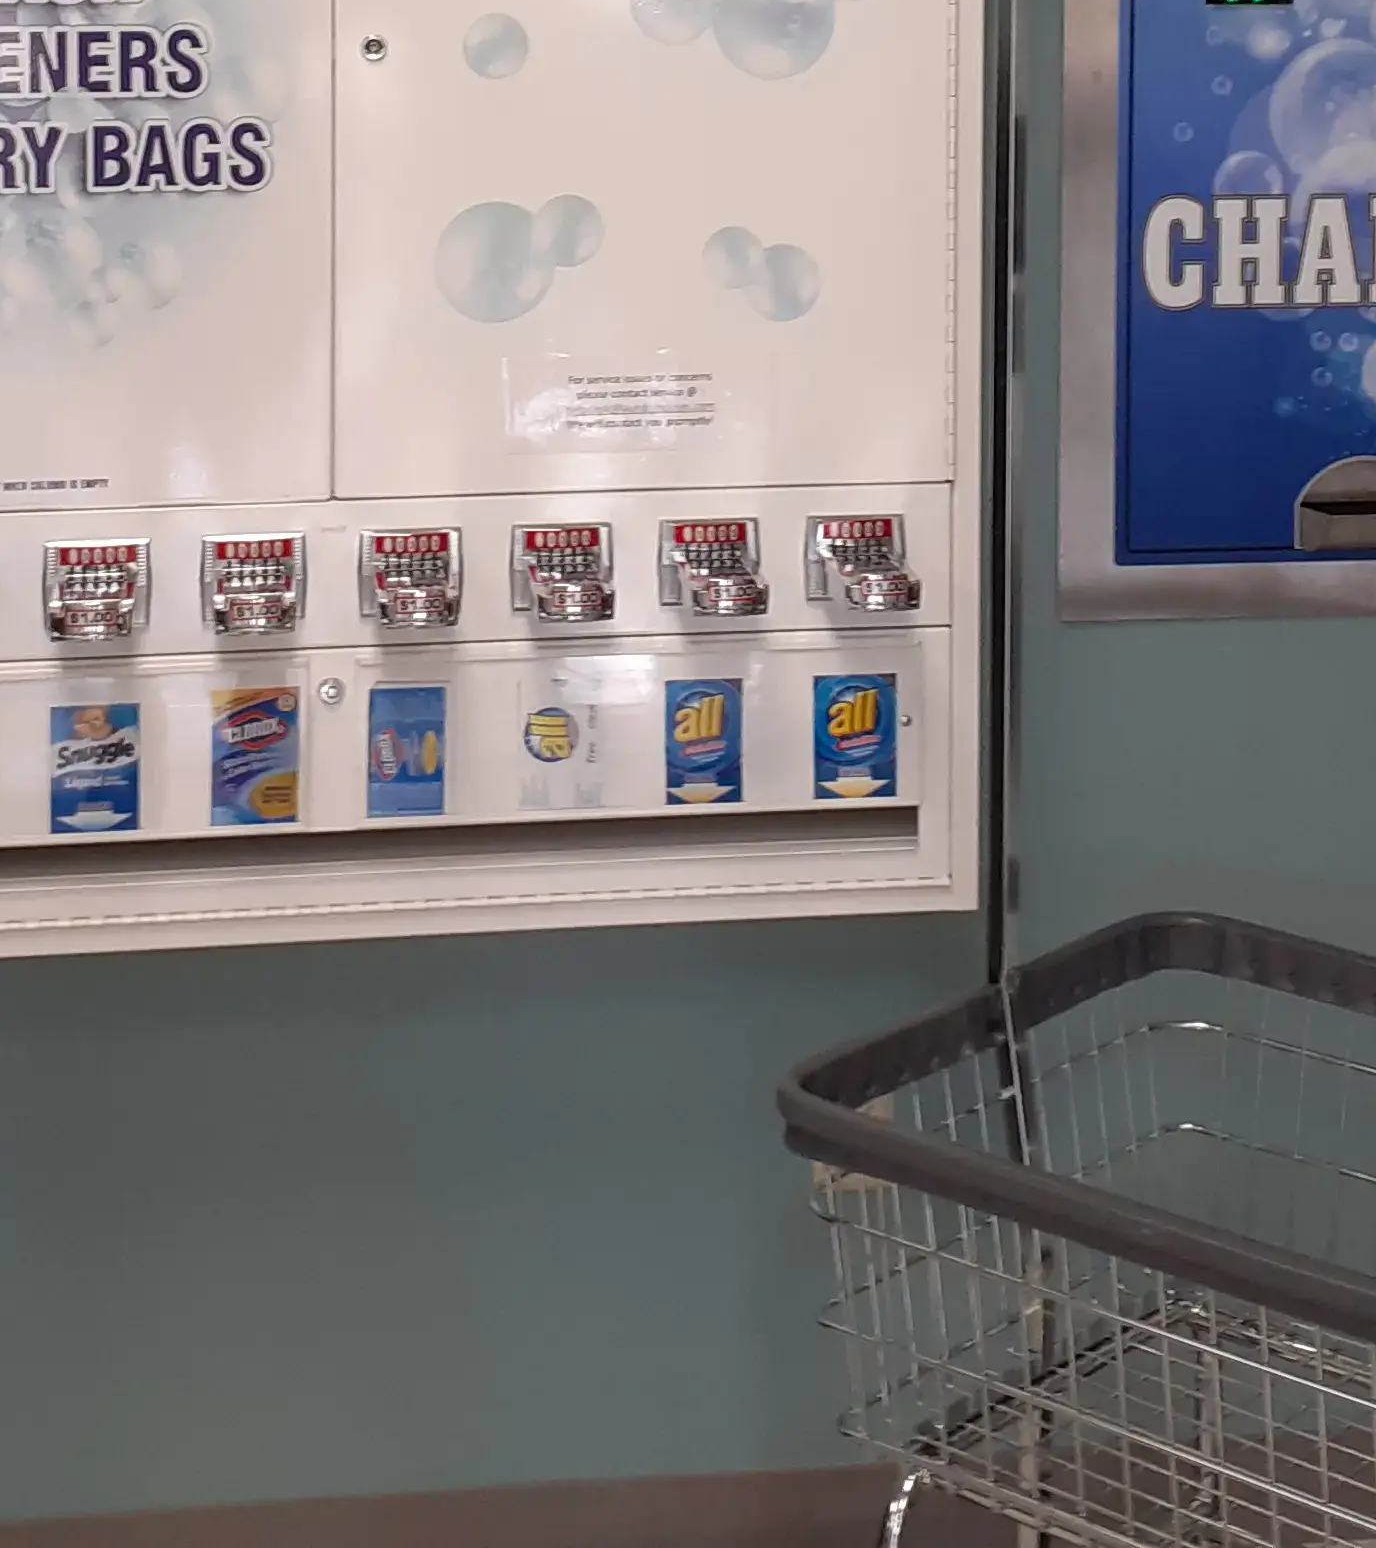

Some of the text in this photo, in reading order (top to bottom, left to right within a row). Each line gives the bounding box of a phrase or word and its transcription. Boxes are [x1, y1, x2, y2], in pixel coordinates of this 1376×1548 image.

[89, 120, 270, 191] BAGS
[527, 714, 574, 760] all
[673, 693, 726, 744] all
[827, 688, 880, 739] all
[56, 736, 136, 770] Snuggle
